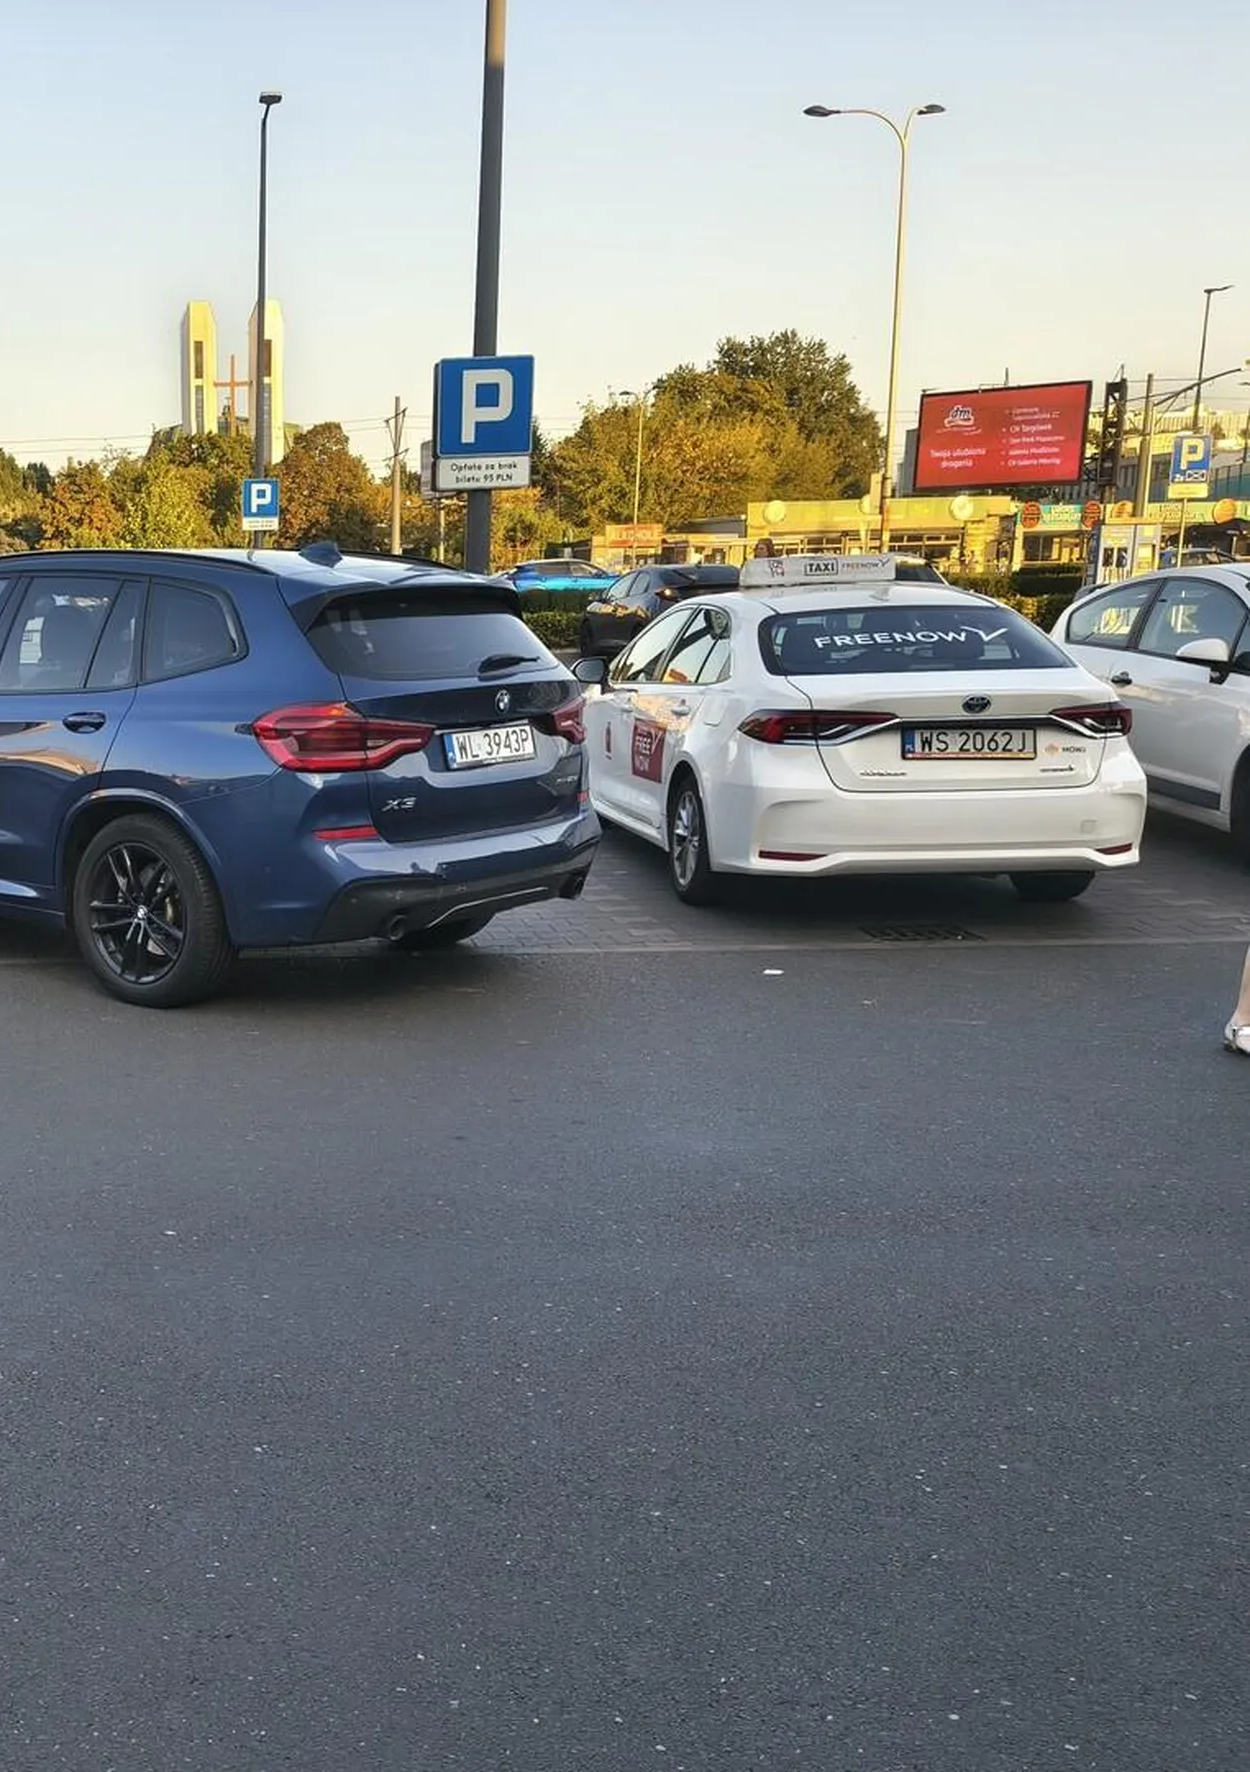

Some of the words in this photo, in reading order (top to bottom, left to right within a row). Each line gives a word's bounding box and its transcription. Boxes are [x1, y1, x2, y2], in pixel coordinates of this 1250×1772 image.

[461, 368, 513, 444] P
[1180, 438, 1204, 470] P
[250, 483, 272, 513] P
[809, 562, 835, 573] TAXI
[814, 630, 967, 649] FREENOW
[456, 734, 480, 760] WL
[483, 728, 529, 756] 3943P
[920, 731, 949, 752] WS
[958, 731, 1026, 752] 2062J
[381, 796, 417, 812] X3
